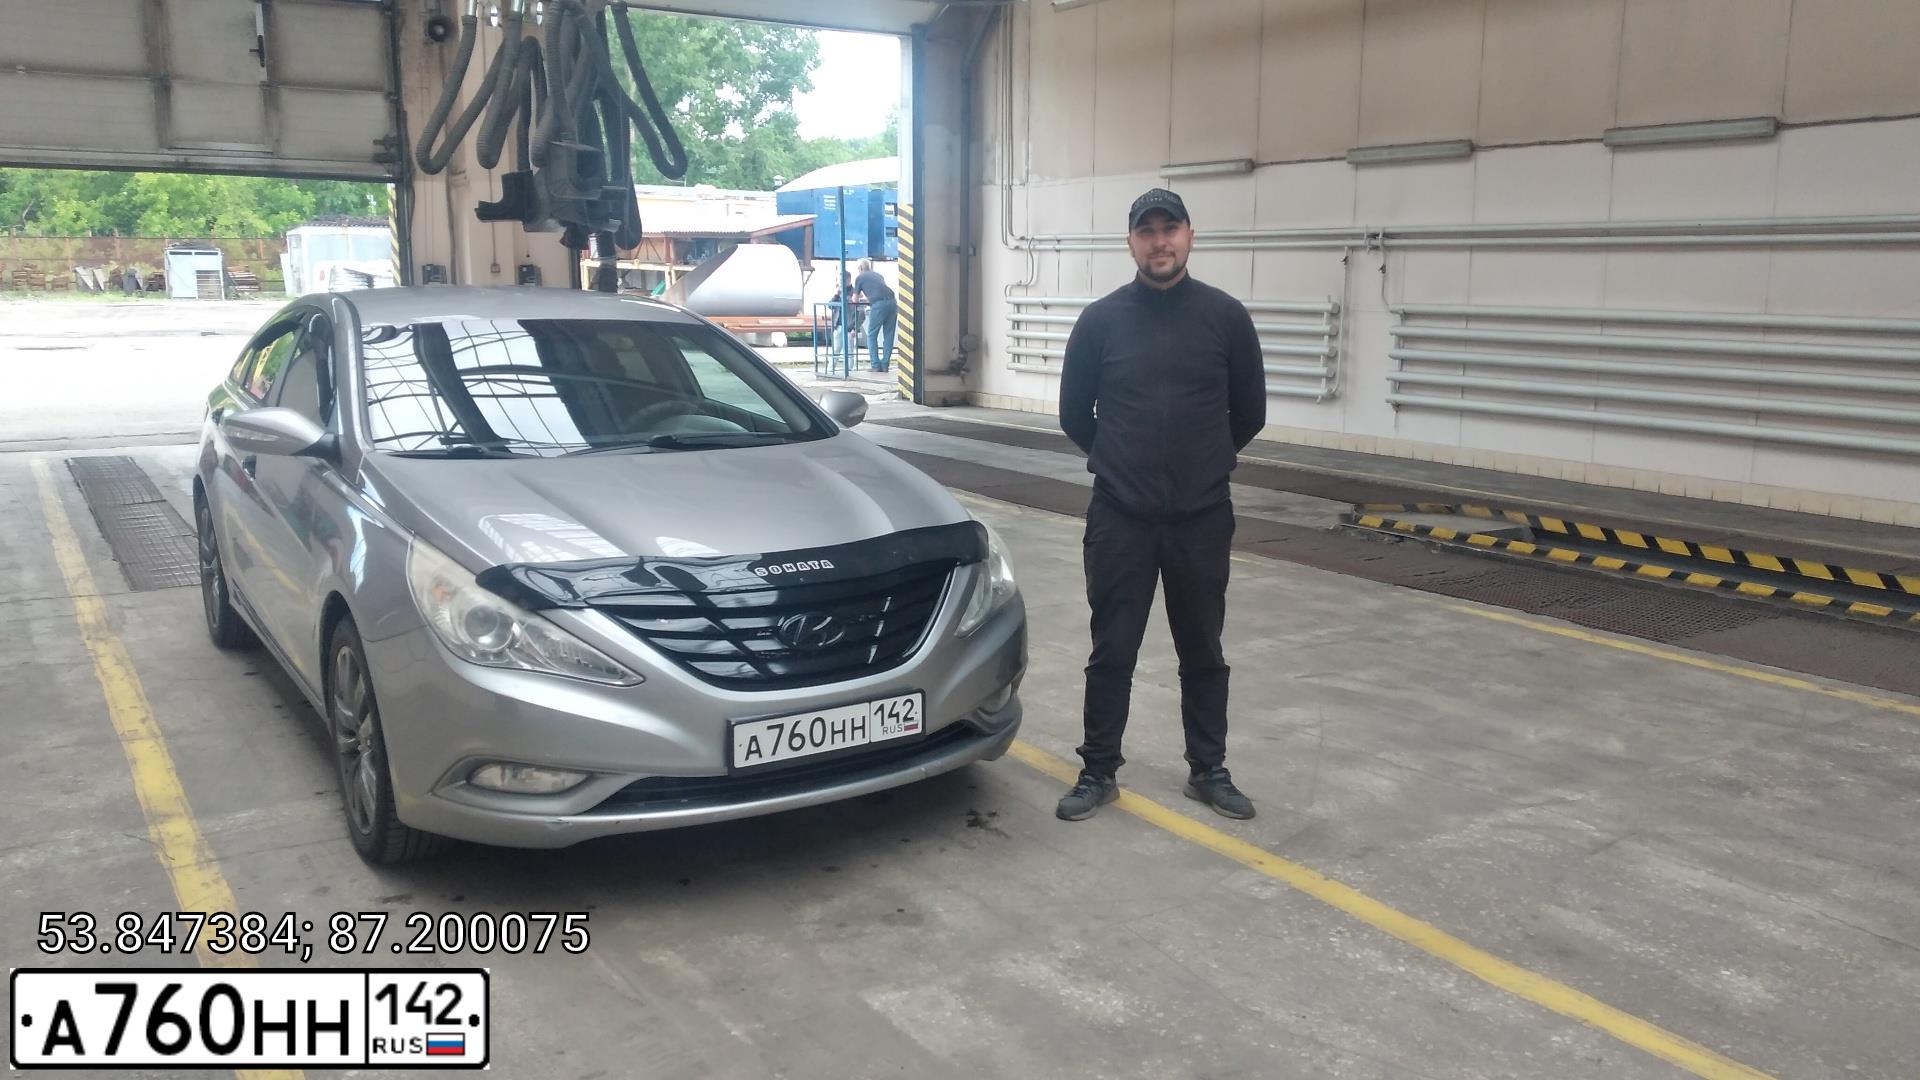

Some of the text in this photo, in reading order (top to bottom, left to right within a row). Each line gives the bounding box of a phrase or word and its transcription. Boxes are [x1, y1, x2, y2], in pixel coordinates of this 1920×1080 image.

[754, 559, 835, 577] SONATA
[873, 698, 916, 727] 142
[882, 723, 904, 736] RUS
